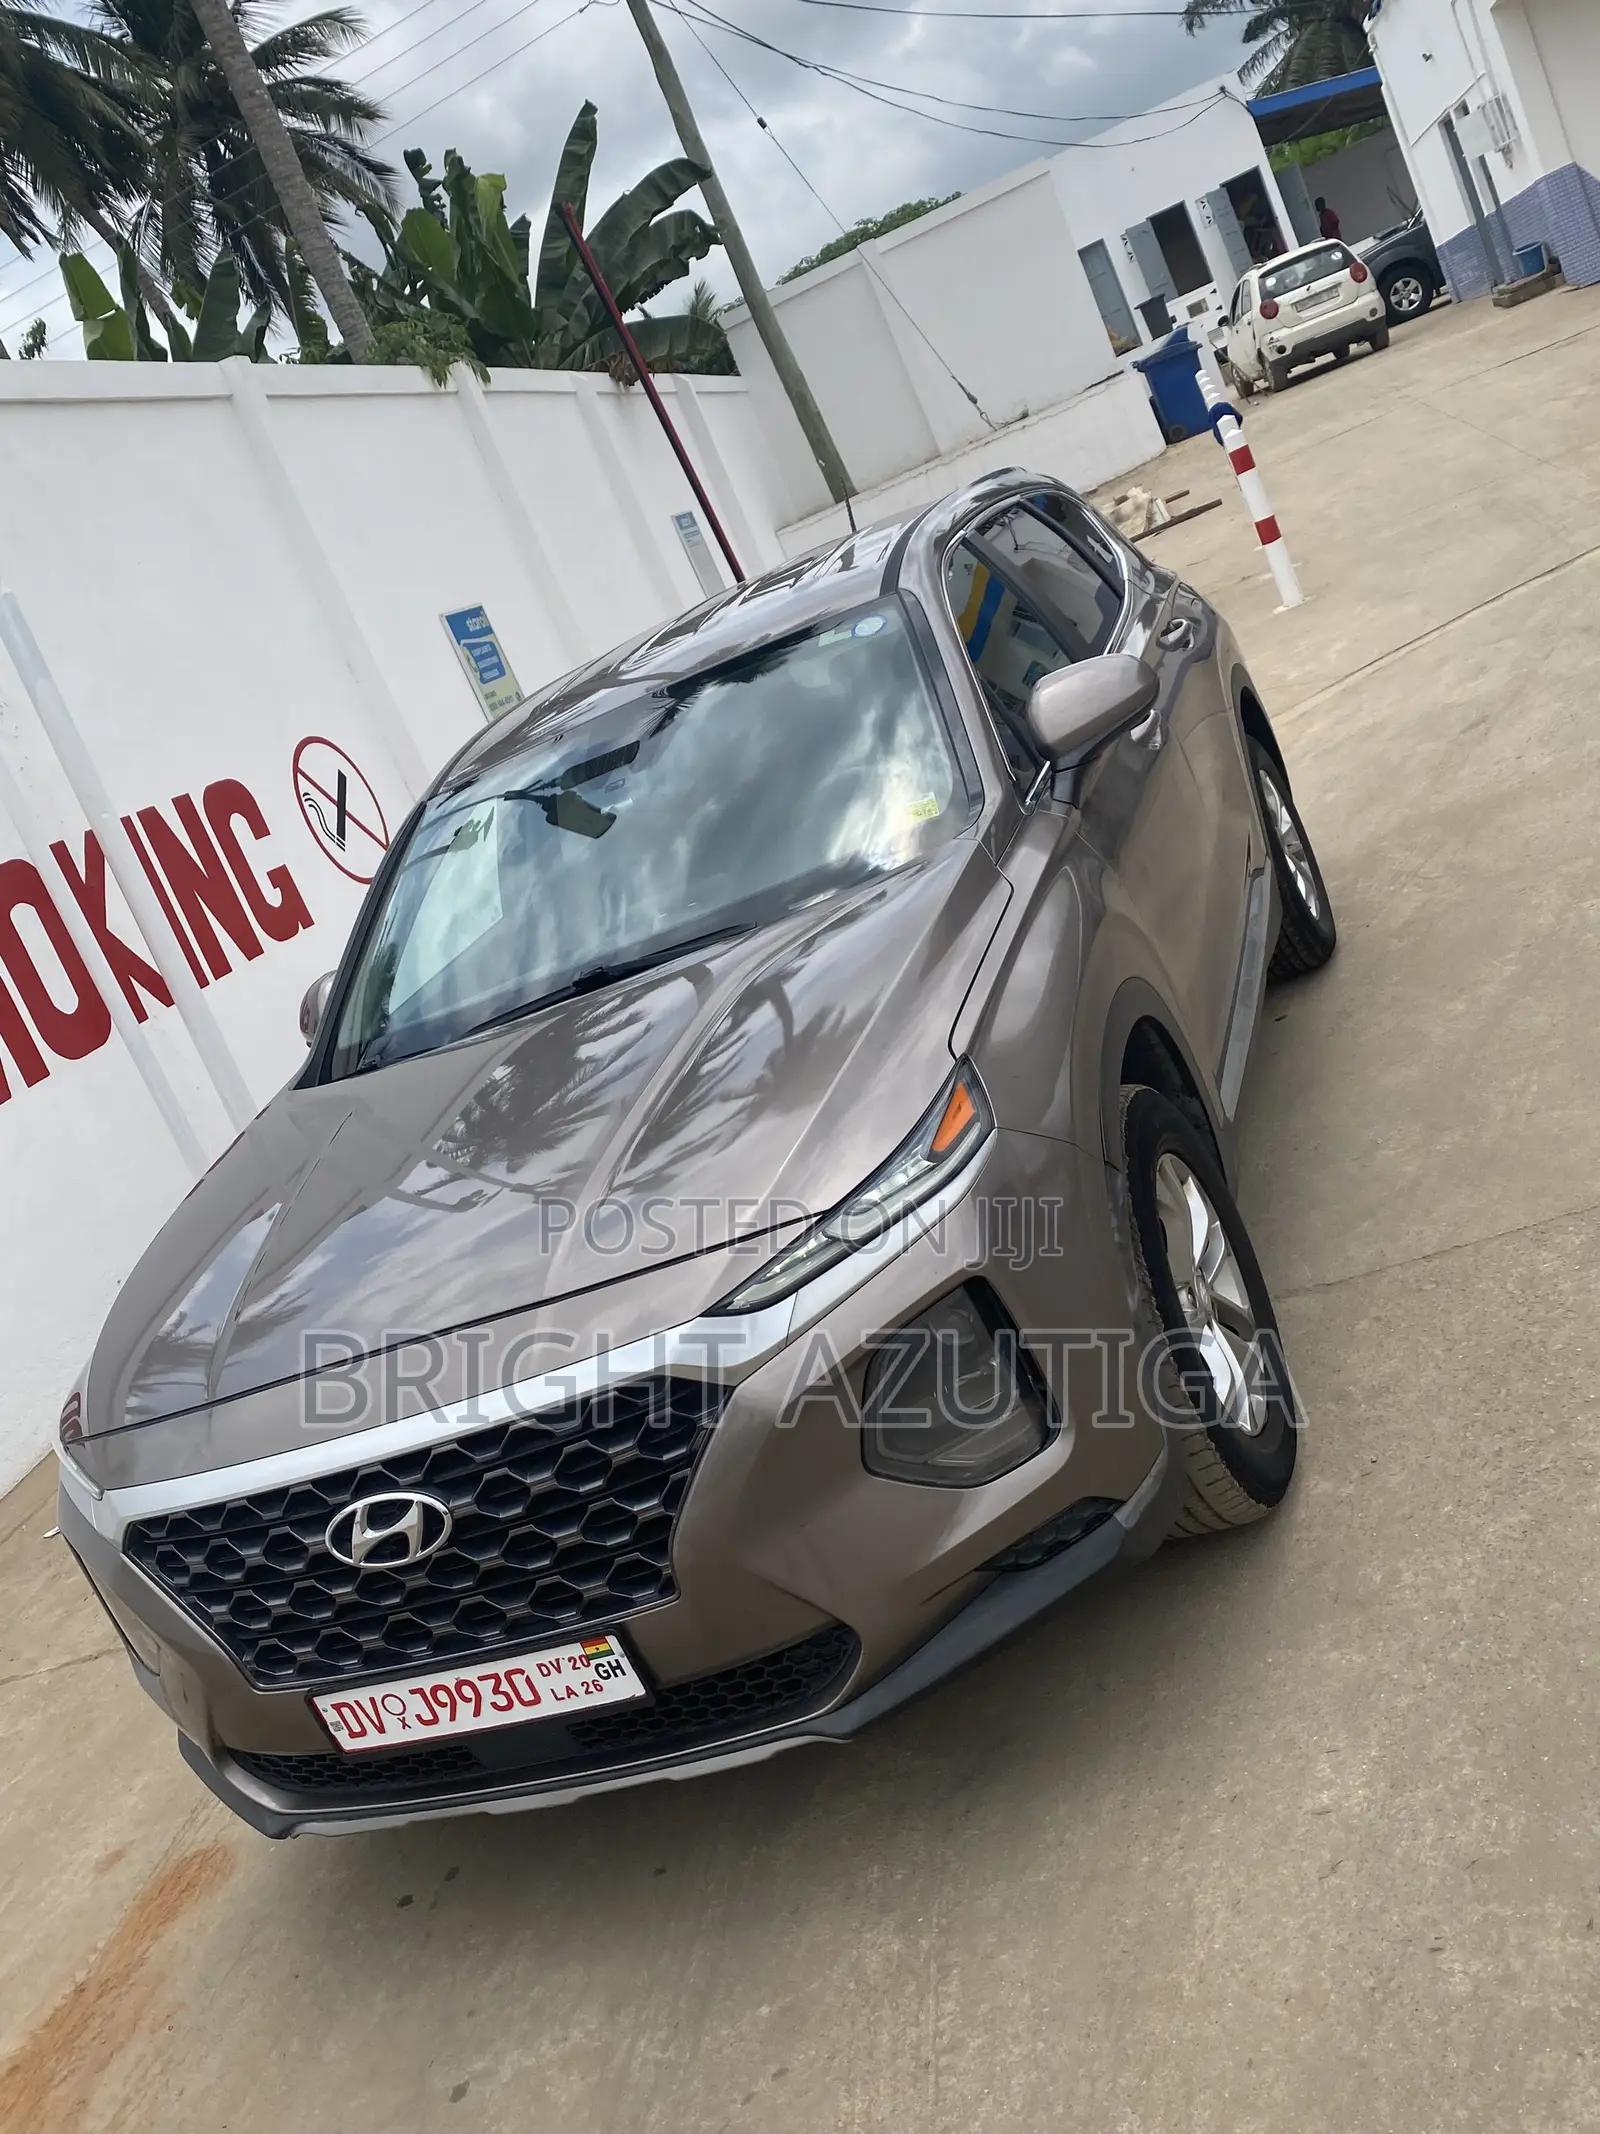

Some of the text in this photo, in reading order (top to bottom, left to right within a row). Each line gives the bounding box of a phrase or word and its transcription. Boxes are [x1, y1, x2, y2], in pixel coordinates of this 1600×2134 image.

[0, 778, 315, 1106] OKING
[594, 1658, 627, 1681] GH
[550, 1679, 604, 1701] LA 26
[330, 1696, 386, 1739] DV
